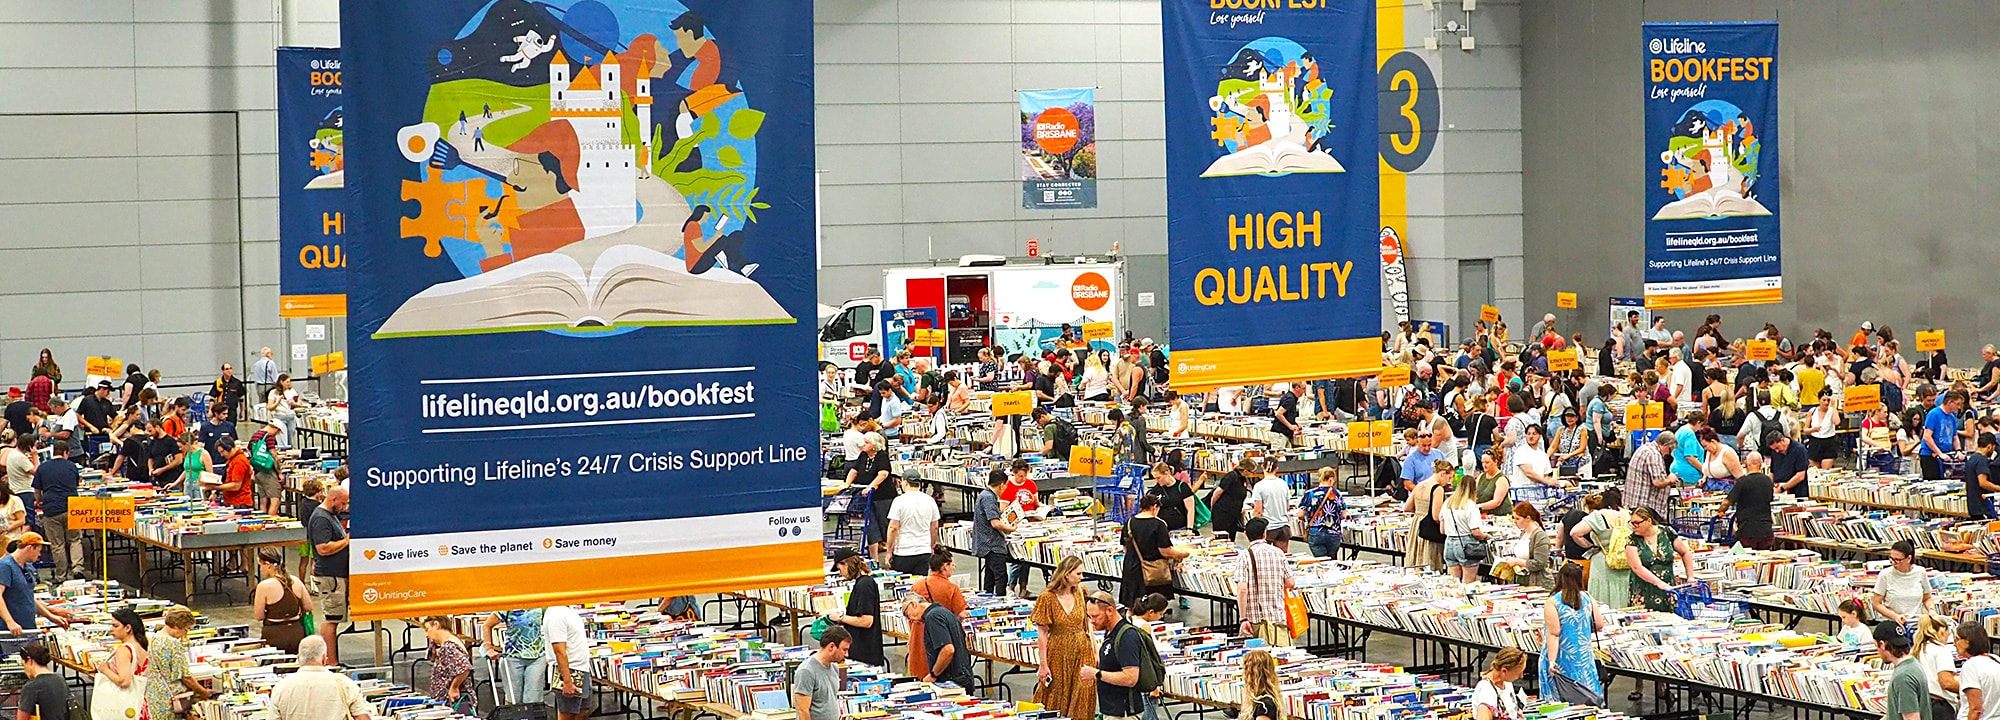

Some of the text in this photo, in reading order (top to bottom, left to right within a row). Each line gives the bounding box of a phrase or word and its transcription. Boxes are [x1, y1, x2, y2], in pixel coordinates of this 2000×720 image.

[1210, 9, 1266, 29] Lose yourself
[1663, 38, 1707, 54] Lifeline
[1650, 57, 1773, 83] BOOKFEST
[1651, 82, 1708, 103] Lose yourself
[1389, 69, 1421, 155] 3
[1036, 129, 1077, 139] BRISBANE
[1228, 210, 1322, 251] HIGH
[1665, 233, 1758, 247] lifelineqld.org.au/bookfest
[1649, 259, 1683, 269] Supporting
[1709, 257, 1723, 266] 24/7
[1738, 256, 1762, 266] Support
[1763, 255, 1777, 263] Line
[1193, 260, 1353, 306] QUALITY
[1073, 289, 1108, 299] BRISBANE
[421, 381, 755, 419] lifelineqld.org.au/bookfest
[366, 463, 477, 490] Supporting
[577, 454, 623, 475] 24/7
[629, 451, 683, 473] Crisis
[690, 445, 764, 470] Support
[768, 443, 807, 463] Line
[768, 515, 811, 526] Follow us
[451, 540, 534, 556] Save the planet
[554, 535, 617, 550] Save money
[378, 547, 430, 561] Save lives
[379, 589, 428, 602] UnitingCare
